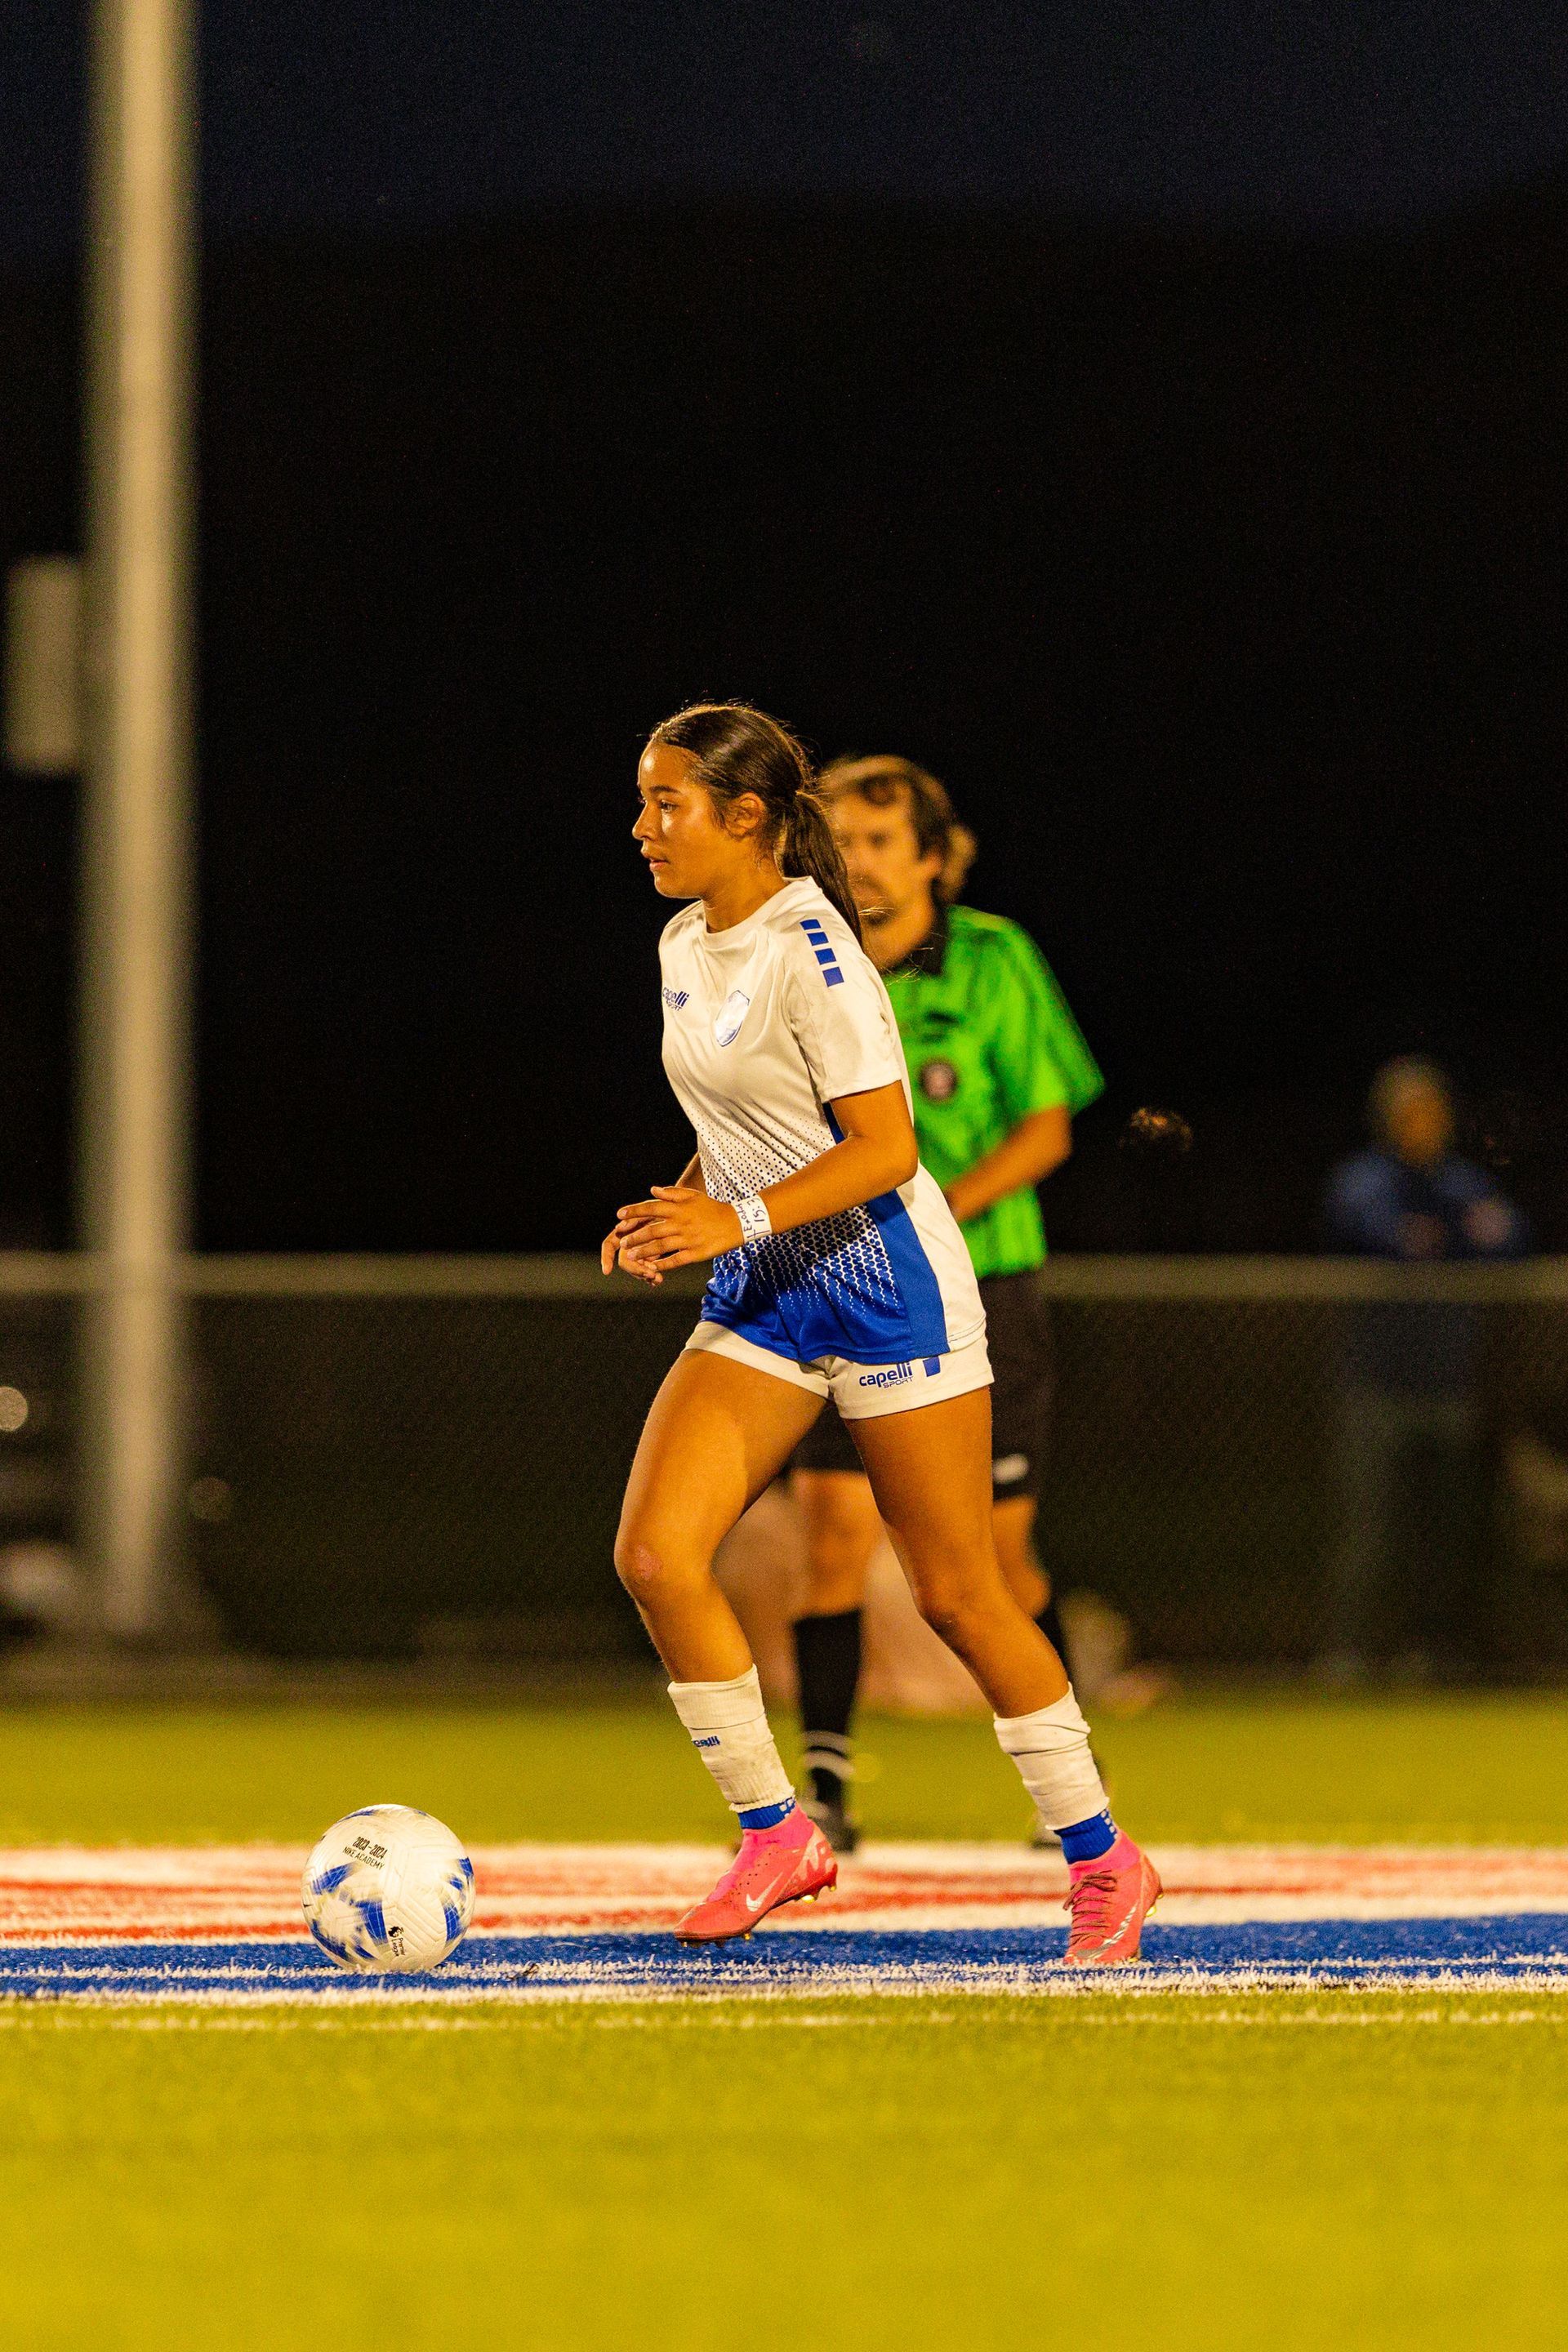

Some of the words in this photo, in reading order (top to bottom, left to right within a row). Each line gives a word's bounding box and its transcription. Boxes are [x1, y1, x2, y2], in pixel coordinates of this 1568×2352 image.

[859, 1362, 913, 1388] capelli
[883, 1376, 913, 1388] SPORT
[342, 1846, 357, 1858] NIKE
[354, 1852, 385, 1870] ACADEMY
